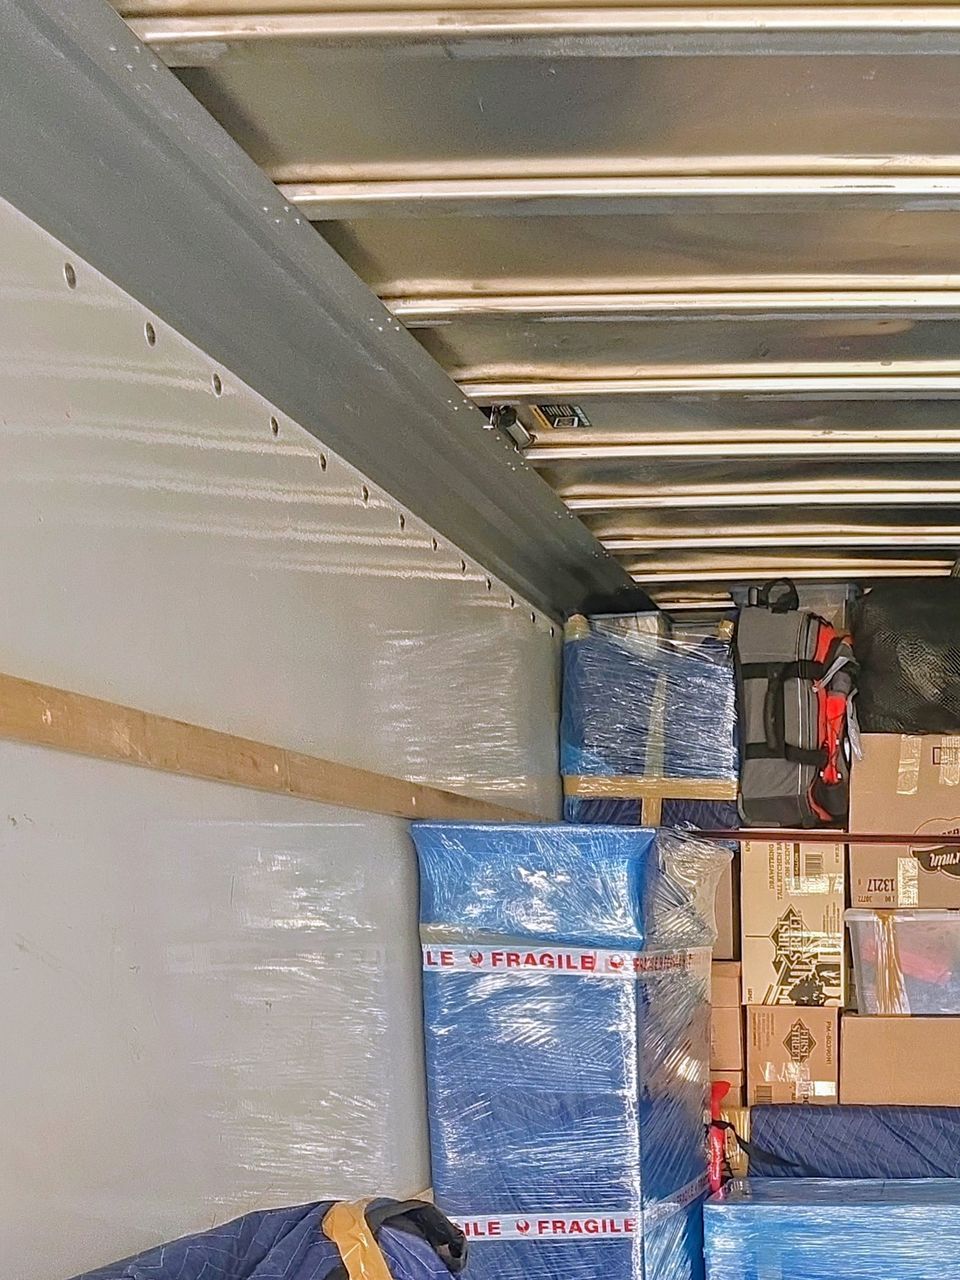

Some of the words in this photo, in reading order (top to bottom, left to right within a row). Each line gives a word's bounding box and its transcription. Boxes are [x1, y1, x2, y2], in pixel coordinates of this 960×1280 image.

[867, 878, 895, 893] 13217
[777, 918, 790, 956] FIRST
[789, 912, 802, 961] STREET
[491, 952, 595, 971] FRAGILE
[791, 1023, 801, 1061] STREET
[800, 1029, 809, 1057] FIRST
[538, 1218, 637, 1234] FRAGILE
